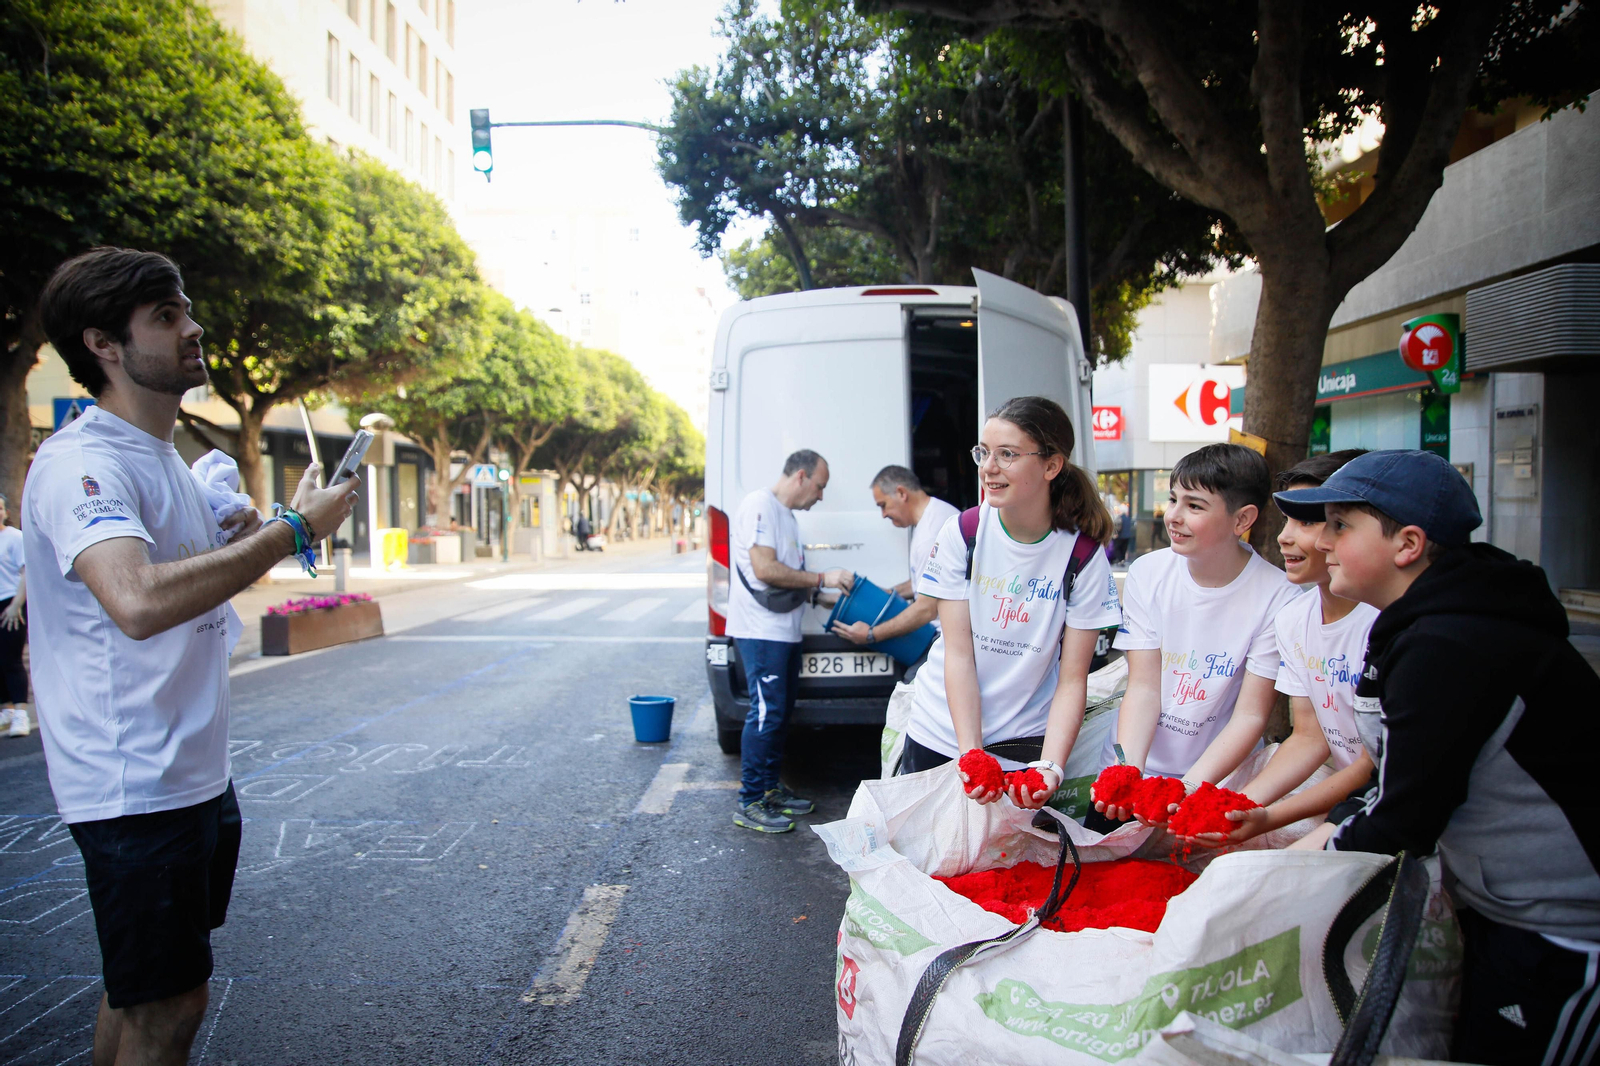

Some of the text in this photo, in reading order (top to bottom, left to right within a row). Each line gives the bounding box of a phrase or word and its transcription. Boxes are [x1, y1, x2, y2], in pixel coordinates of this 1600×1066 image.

[1318, 368, 1356, 394] Unicaja
[76, 510, 88, 521] DE
[1007, 574, 1023, 595] de
[990, 638, 1015, 648] INTERÉS
[990, 647, 1023, 657] ANDALUCÍA
[800, 655, 889, 675] 826 HYJ
[1172, 669, 1208, 706] Tíjola
